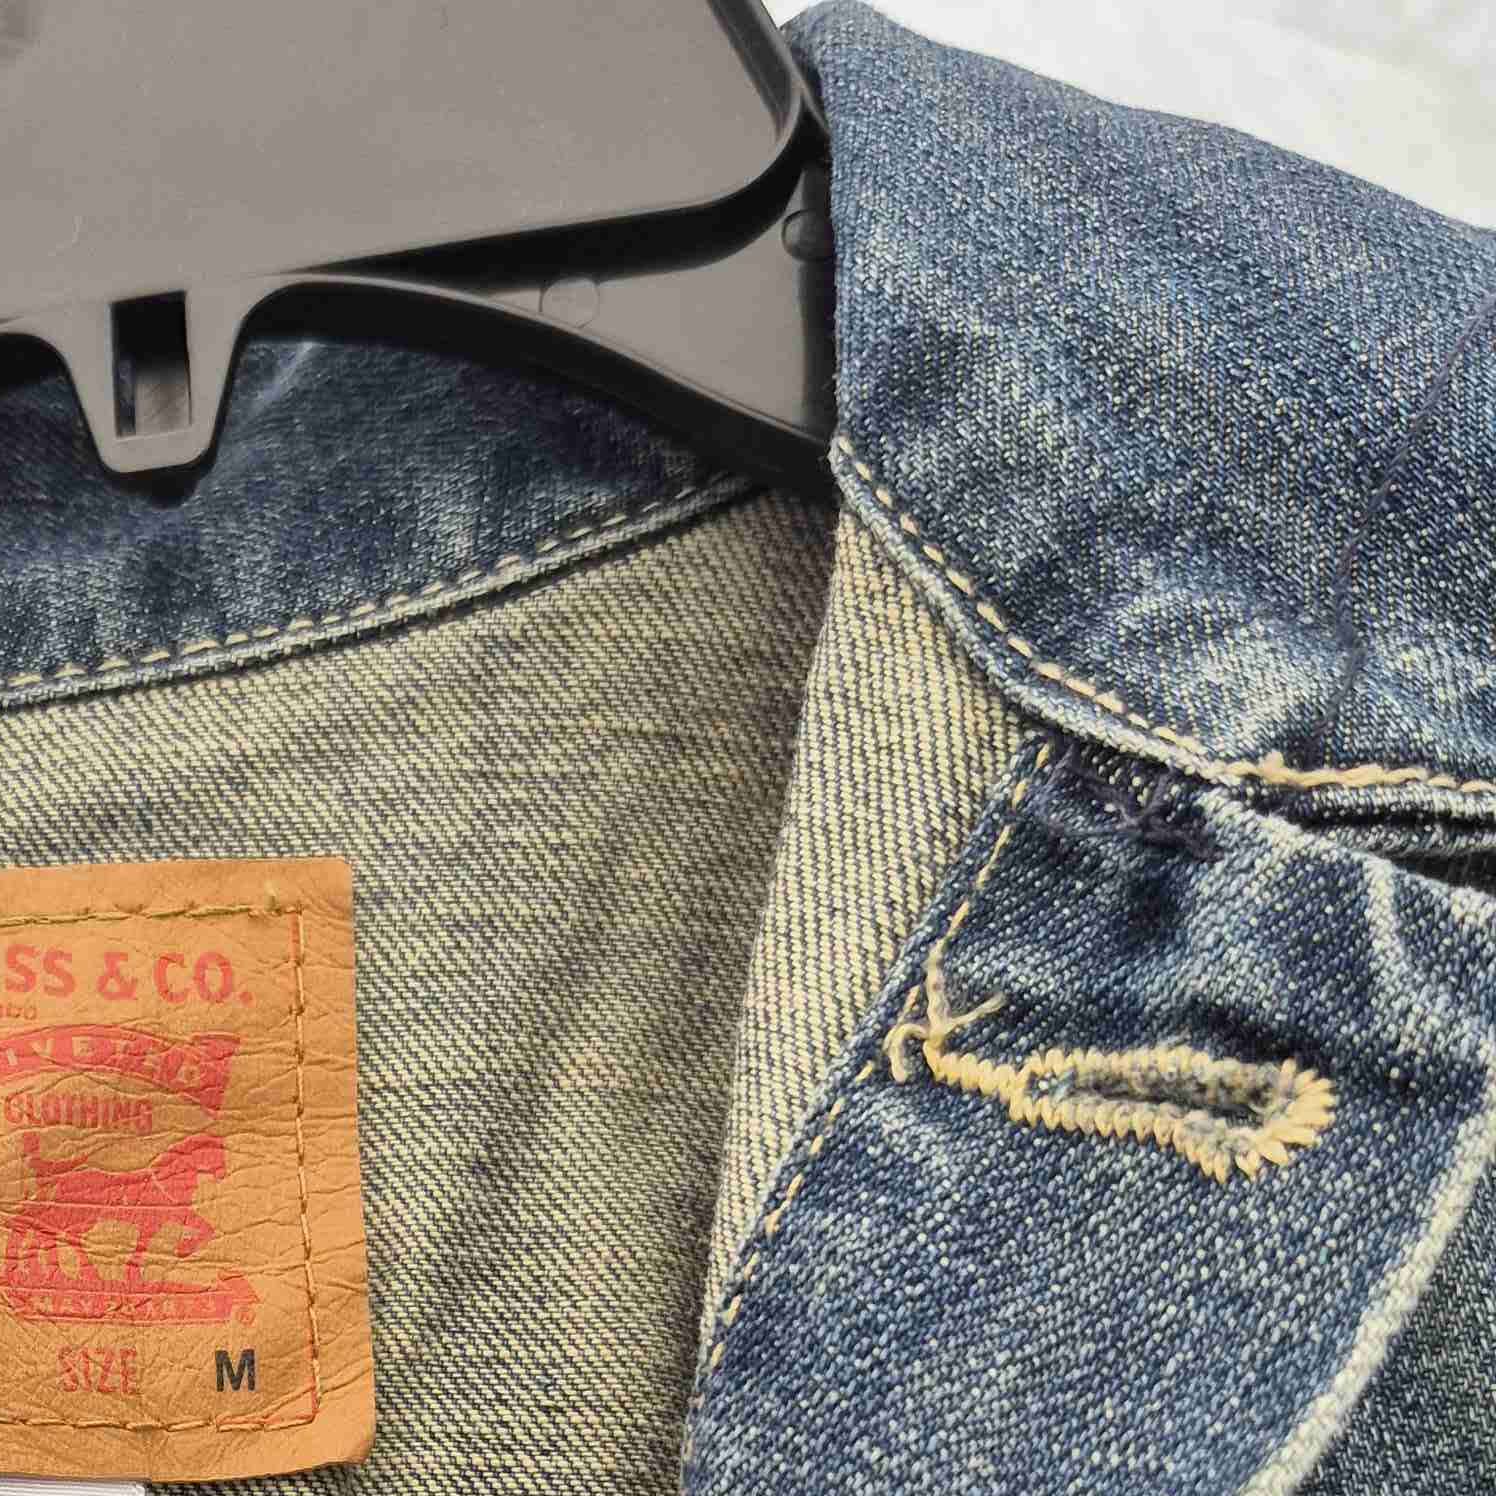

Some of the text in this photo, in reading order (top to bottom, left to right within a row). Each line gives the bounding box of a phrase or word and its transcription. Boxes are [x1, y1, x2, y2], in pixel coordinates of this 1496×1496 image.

[96, 950, 137, 1000] &
[153, 950, 255, 1007] CO.
[4, 1091, 153, 1136] CLOTHING
[57, 1346, 257, 1395] SIZE M
